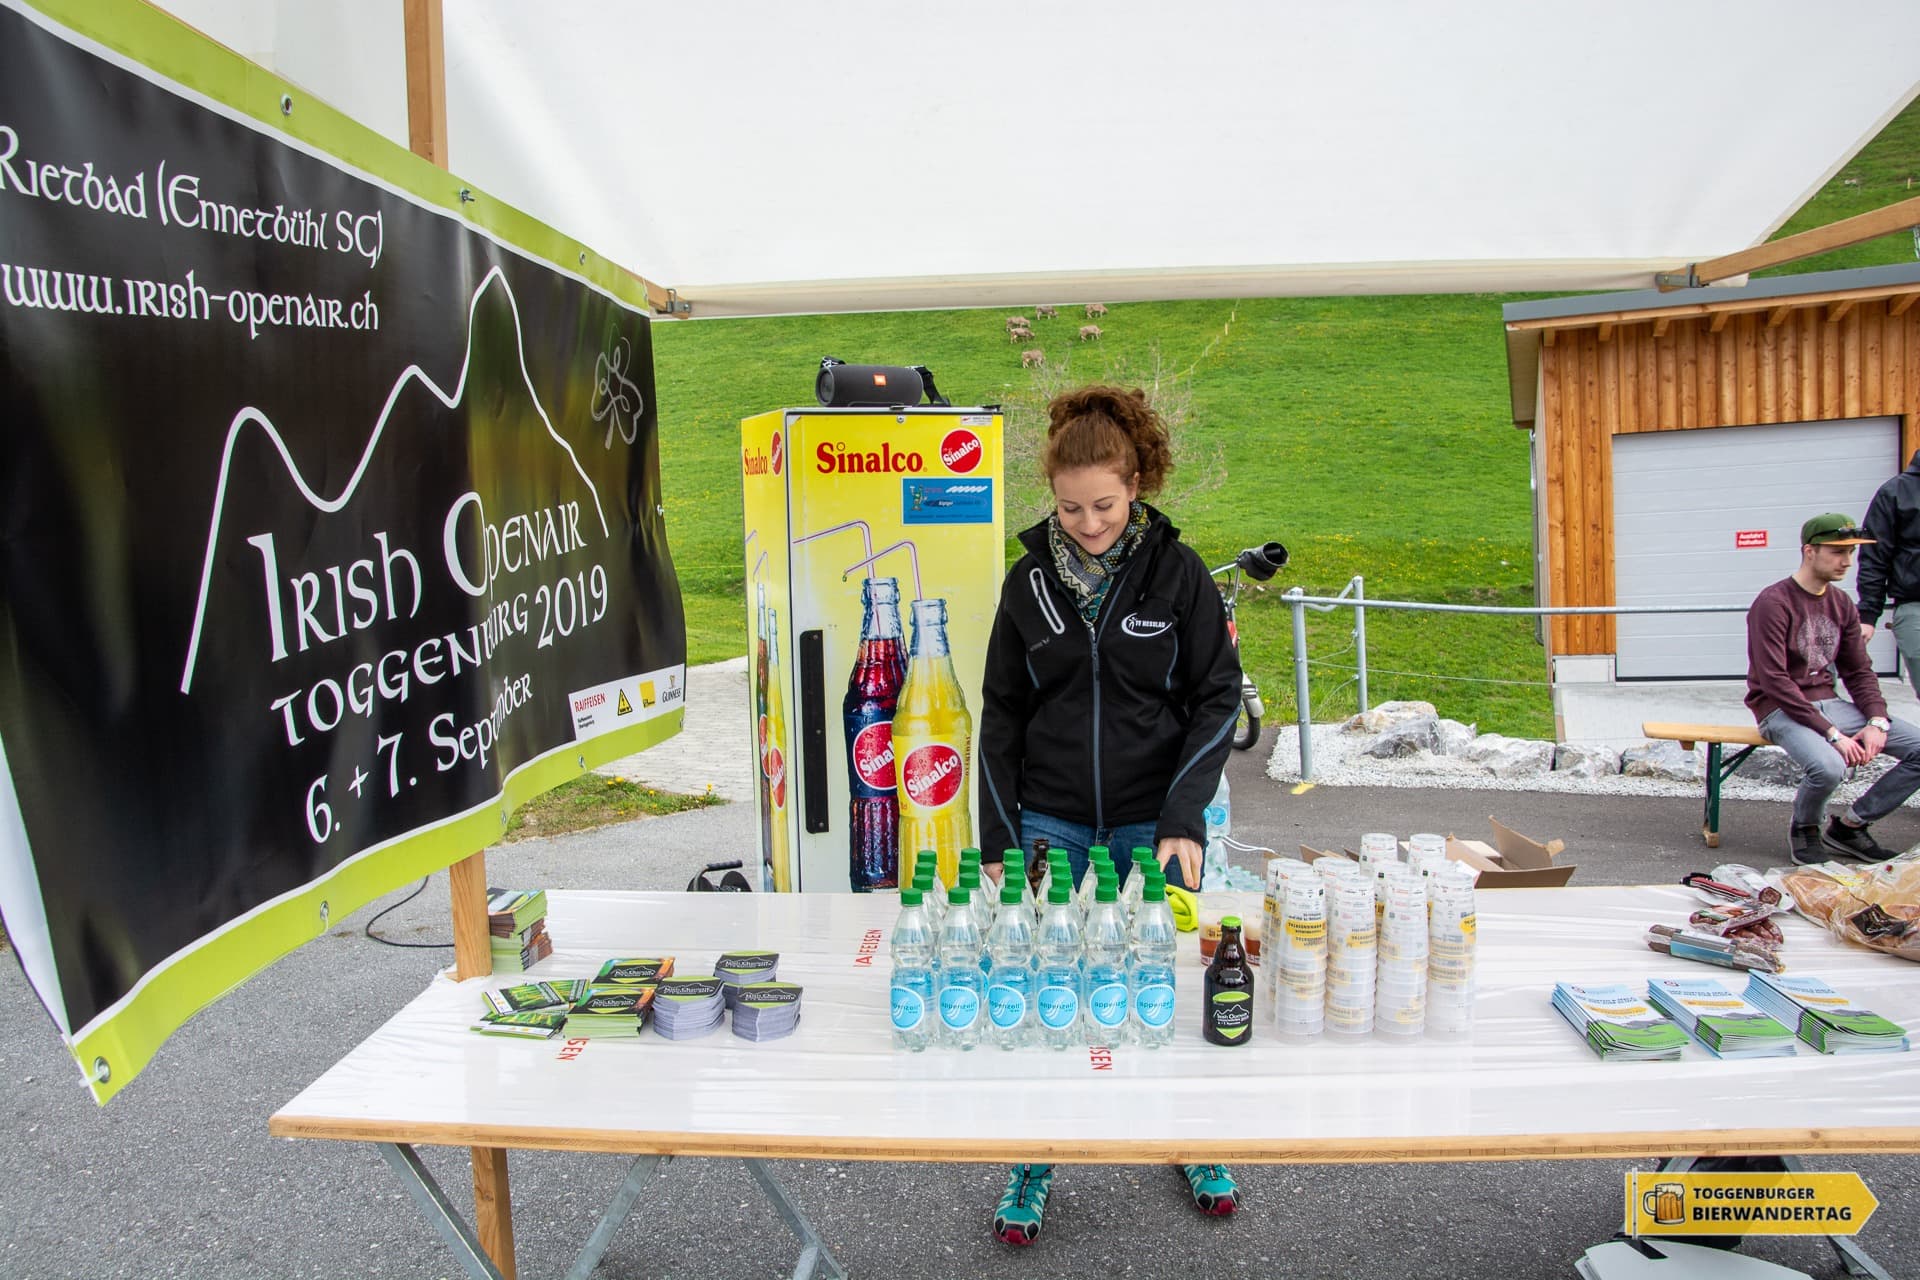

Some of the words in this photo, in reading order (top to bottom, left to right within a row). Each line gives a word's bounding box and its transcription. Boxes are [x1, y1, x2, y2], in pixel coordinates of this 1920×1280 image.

[0, 125, 148, 219] Rietbad
[336, 210, 384, 269] SG)
[1, 263, 380, 340] www.irish-openair.ch
[816, 441, 924, 475] Sinalco
[943, 439, 979, 466] Sinalco
[535, 563, 609, 649] 2019
[574, 692, 606, 712] RAIFFEISEN
[306, 774, 342, 845] 6.
[377, 732, 417, 799] 7.
[906, 755, 959, 797] Sinalco
